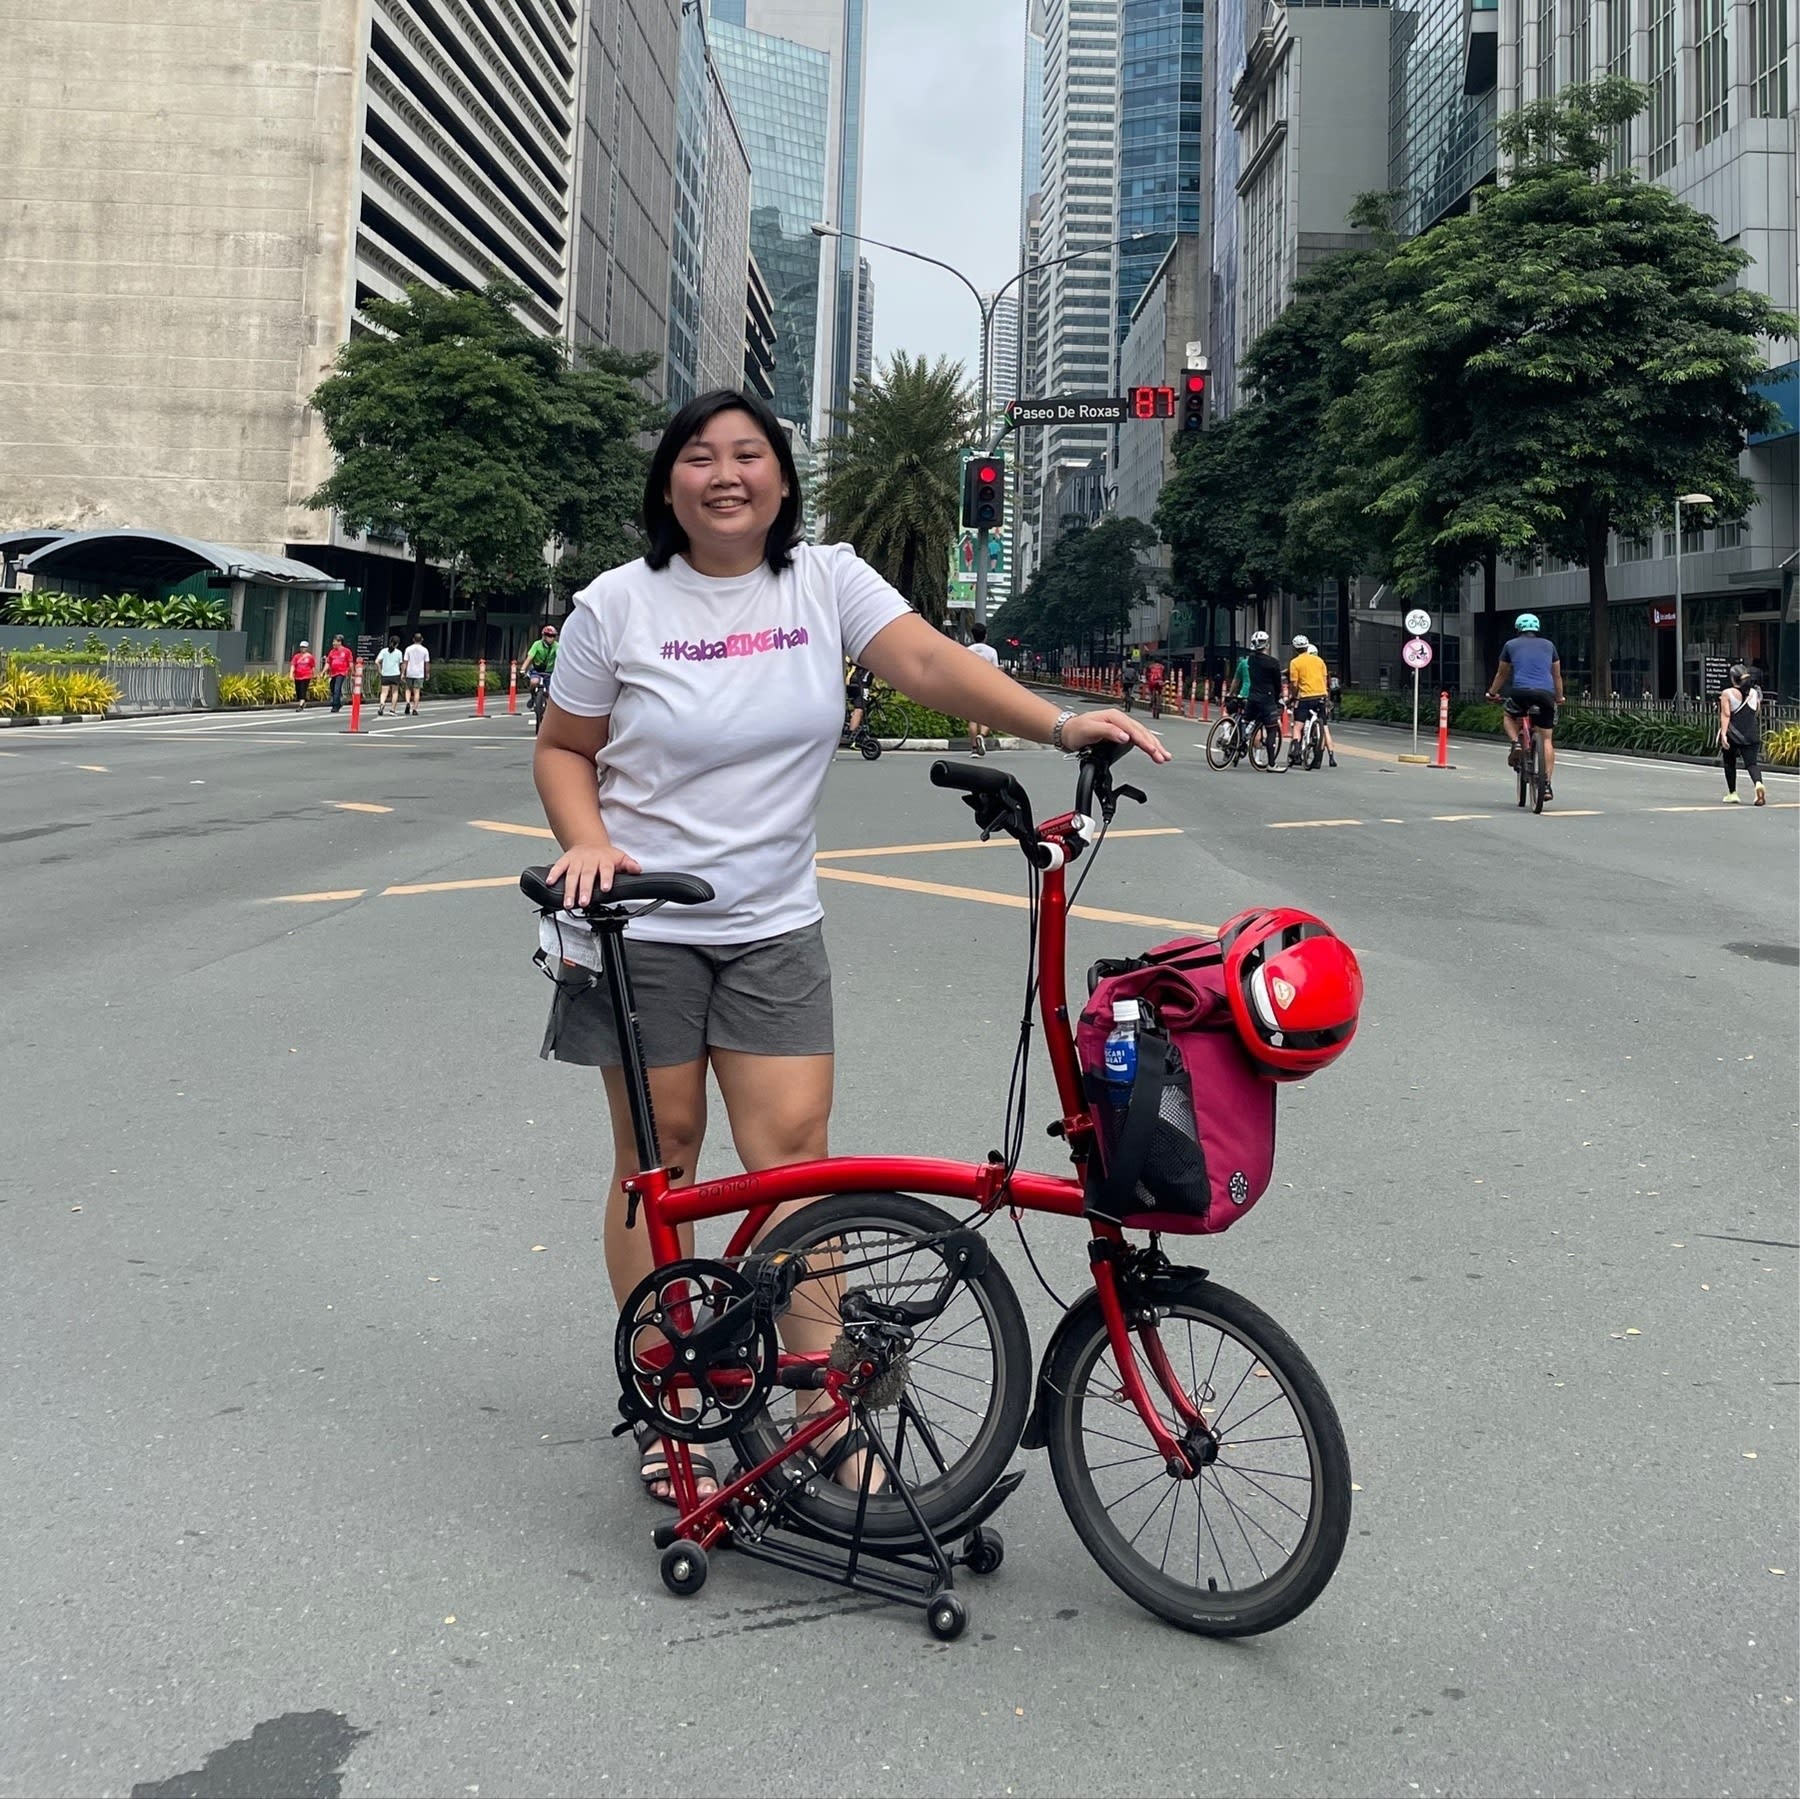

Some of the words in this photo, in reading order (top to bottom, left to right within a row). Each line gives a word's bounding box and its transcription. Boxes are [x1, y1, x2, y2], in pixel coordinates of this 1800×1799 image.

[1013, 406, 1054, 420] Paseo
[1058, 405, 1075, 418] De
[1079, 404, 1120, 418] Roxas
[1135, 387, 1173, 419] 87
